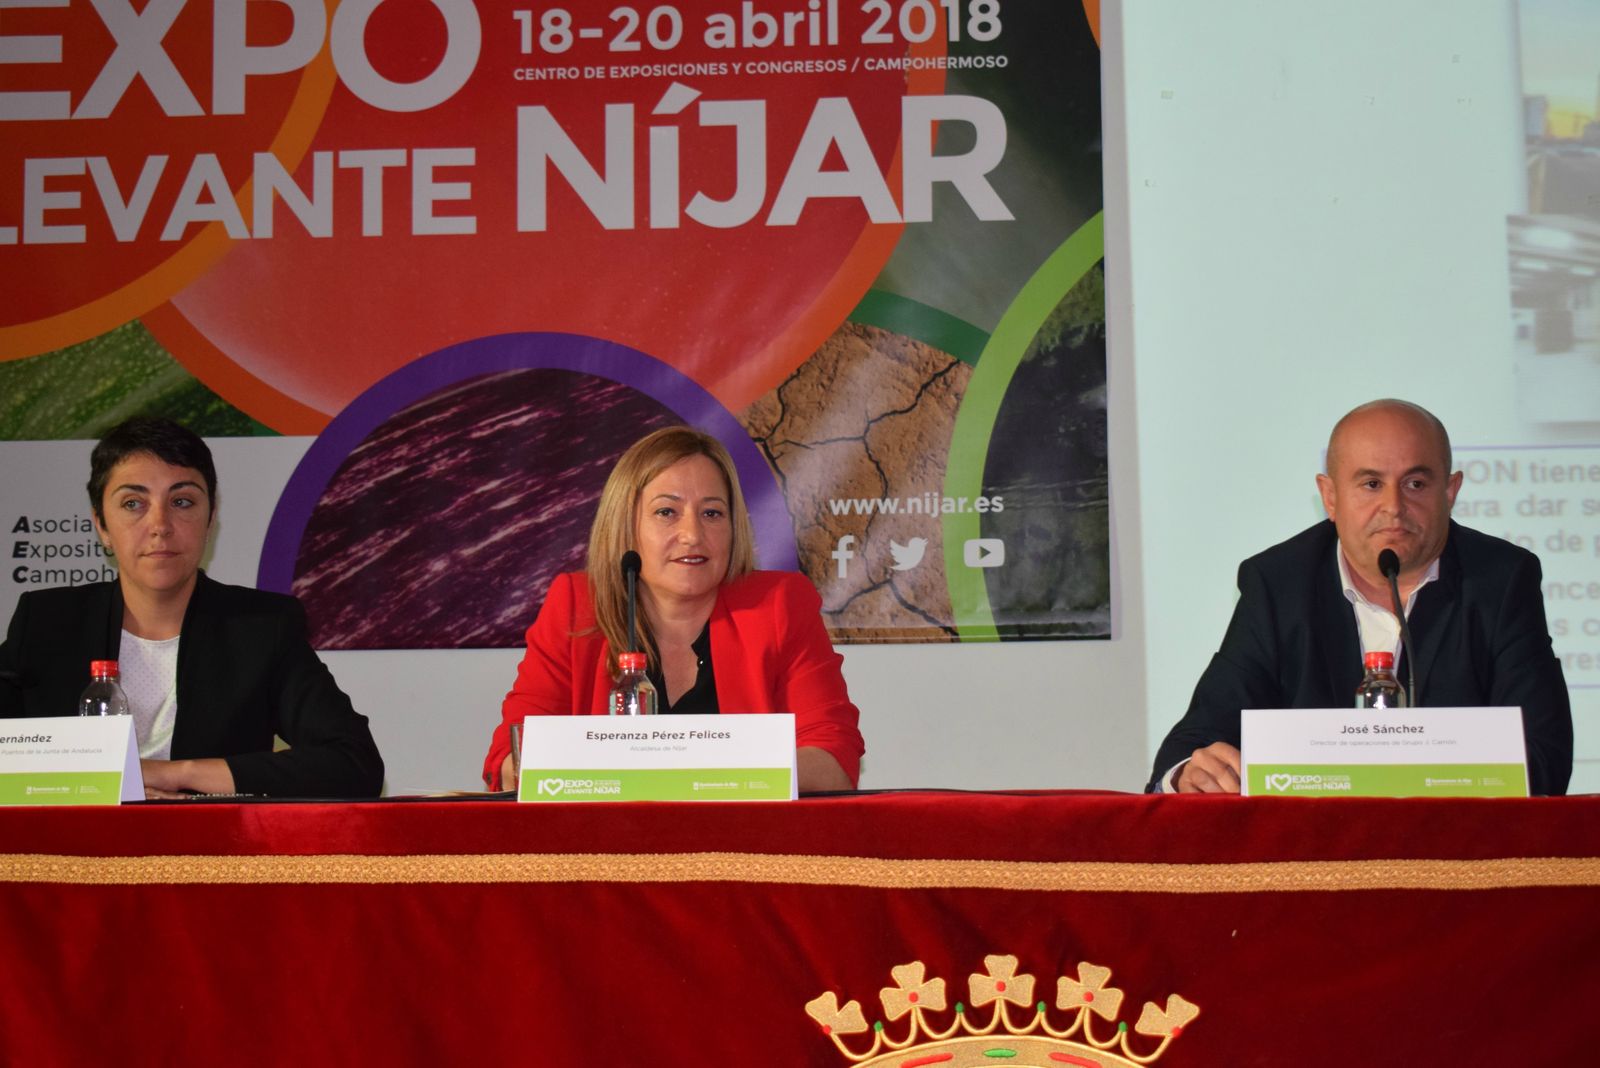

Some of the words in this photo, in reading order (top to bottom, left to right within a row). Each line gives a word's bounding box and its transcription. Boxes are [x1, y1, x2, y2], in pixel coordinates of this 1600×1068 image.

[513, 5, 684, 55] 18-20
[703, 0, 839, 49] abril
[860, 0, 1003, 45] 2018
[513, 67, 580, 81] CENTRO
[584, 66, 605, 79] DE
[609, 62, 729, 78] EXPOSICIONES
[731, 62, 742, 75] Y
[745, 59, 848, 74] CONGRESOS
[864, 55, 1009, 71] CAMPOHERMOSO
[1457, 459, 1519, 484] ON
[829, 492, 1005, 518] www.nijar.es
[1515, 493, 1569, 517] dar
[12, 515, 92, 534] Asocia
[586, 731, 648, 742] Esperanza
[652, 729, 686, 741] Pérez
[689, 730, 731, 740] Felices
[1340, 724, 1369, 735] José
[1373, 724, 1425, 735] Sánchez
